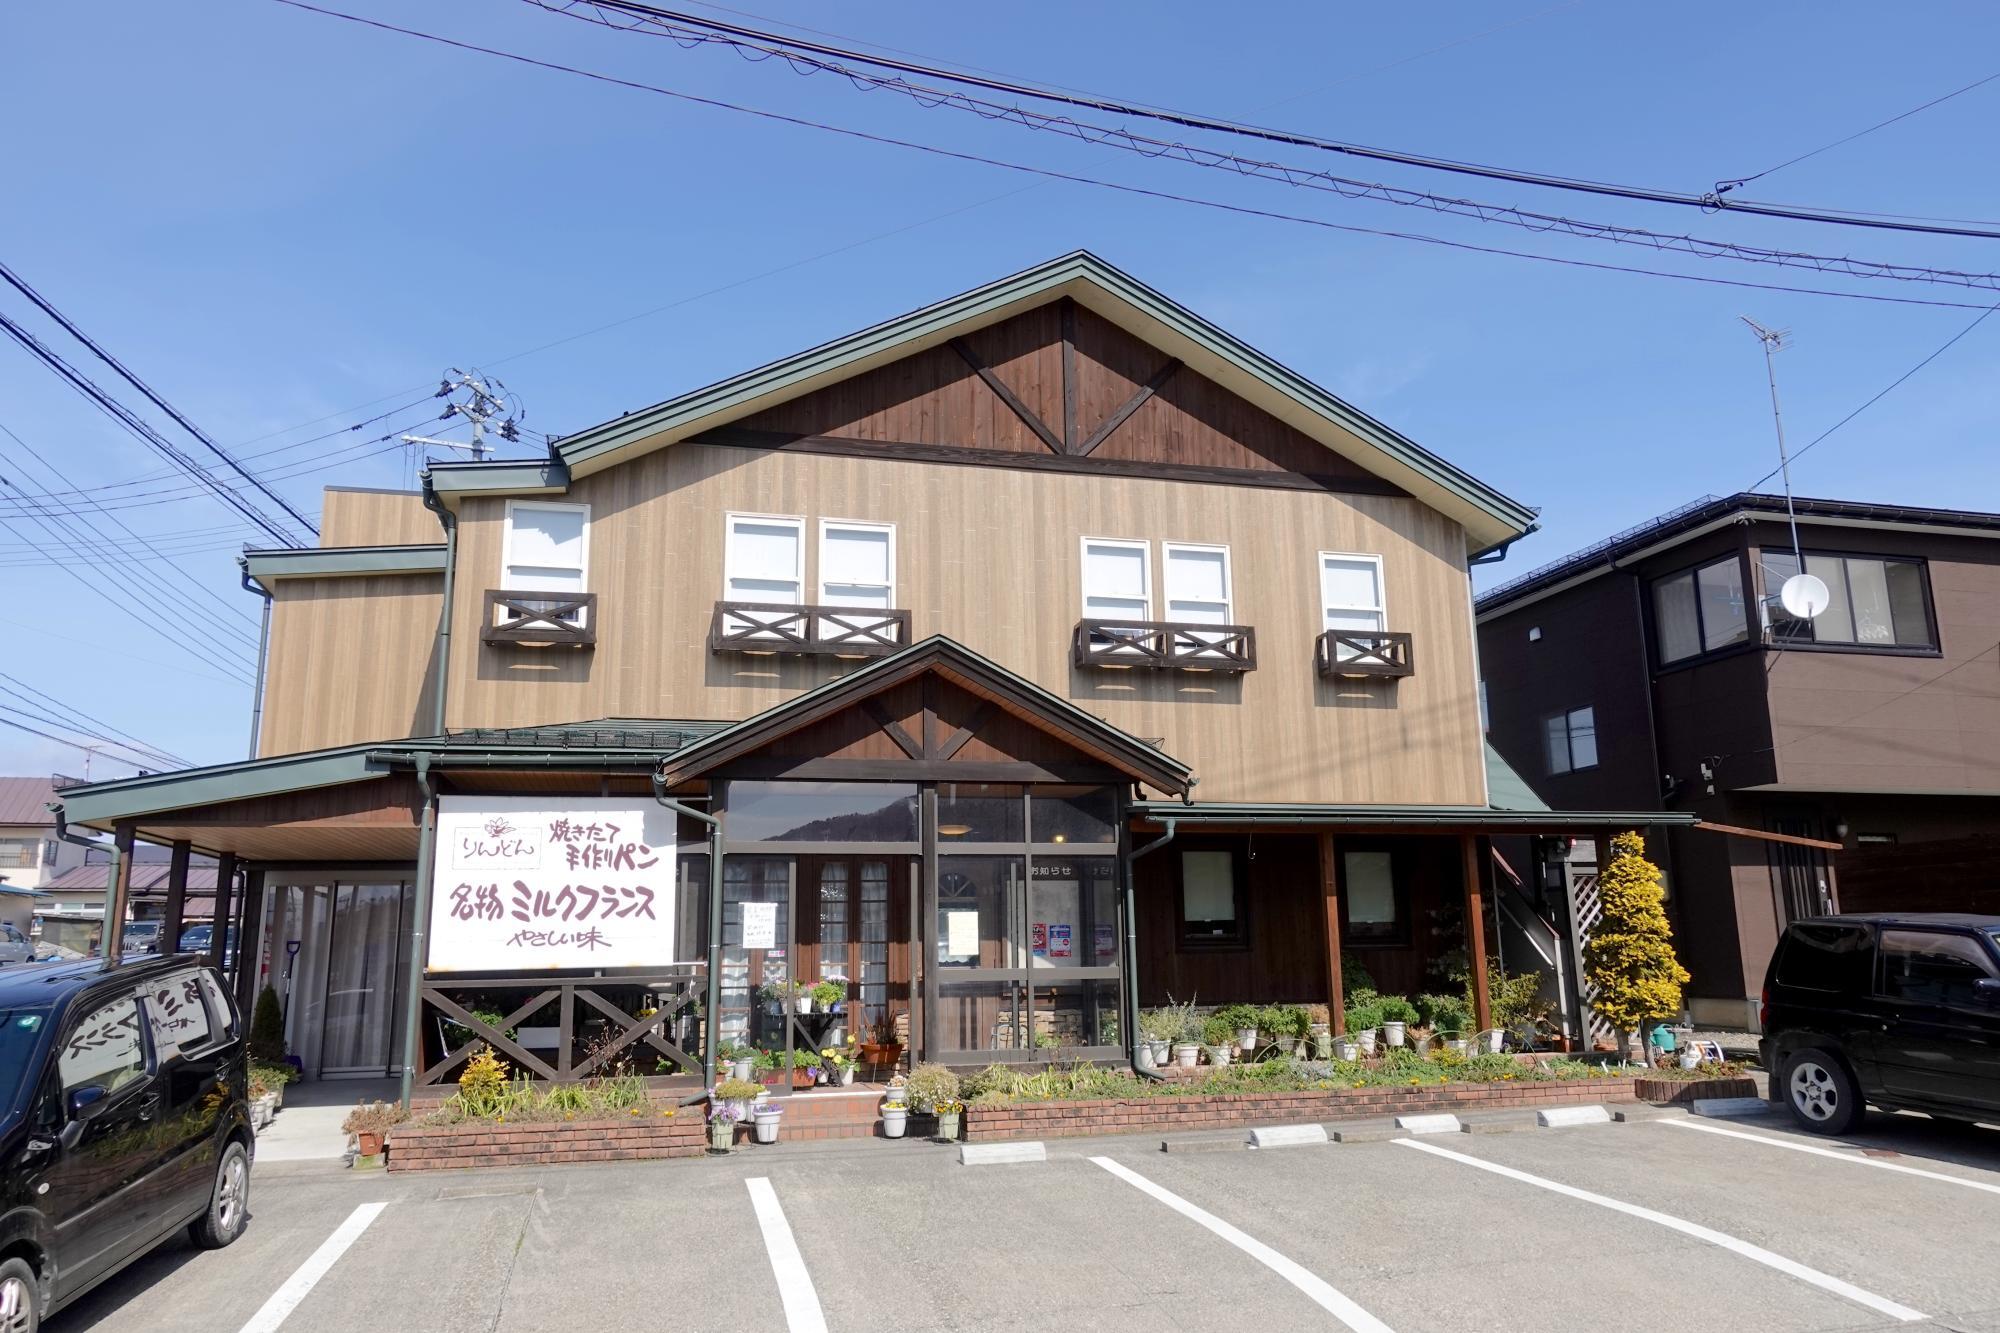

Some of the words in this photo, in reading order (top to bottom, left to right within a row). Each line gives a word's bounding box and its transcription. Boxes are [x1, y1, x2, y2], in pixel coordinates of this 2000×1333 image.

[549, 818, 621, 844] 焼きたて
[463, 837, 535, 859] りんどん
[566, 843, 660, 872] 手作りパン
[1031, 866, 1072, 875] お知らせ
[449, 882, 504, 921] 名物
[511, 880, 656, 923] ミルクフランス
[506, 926, 612, 951] やさしい味
